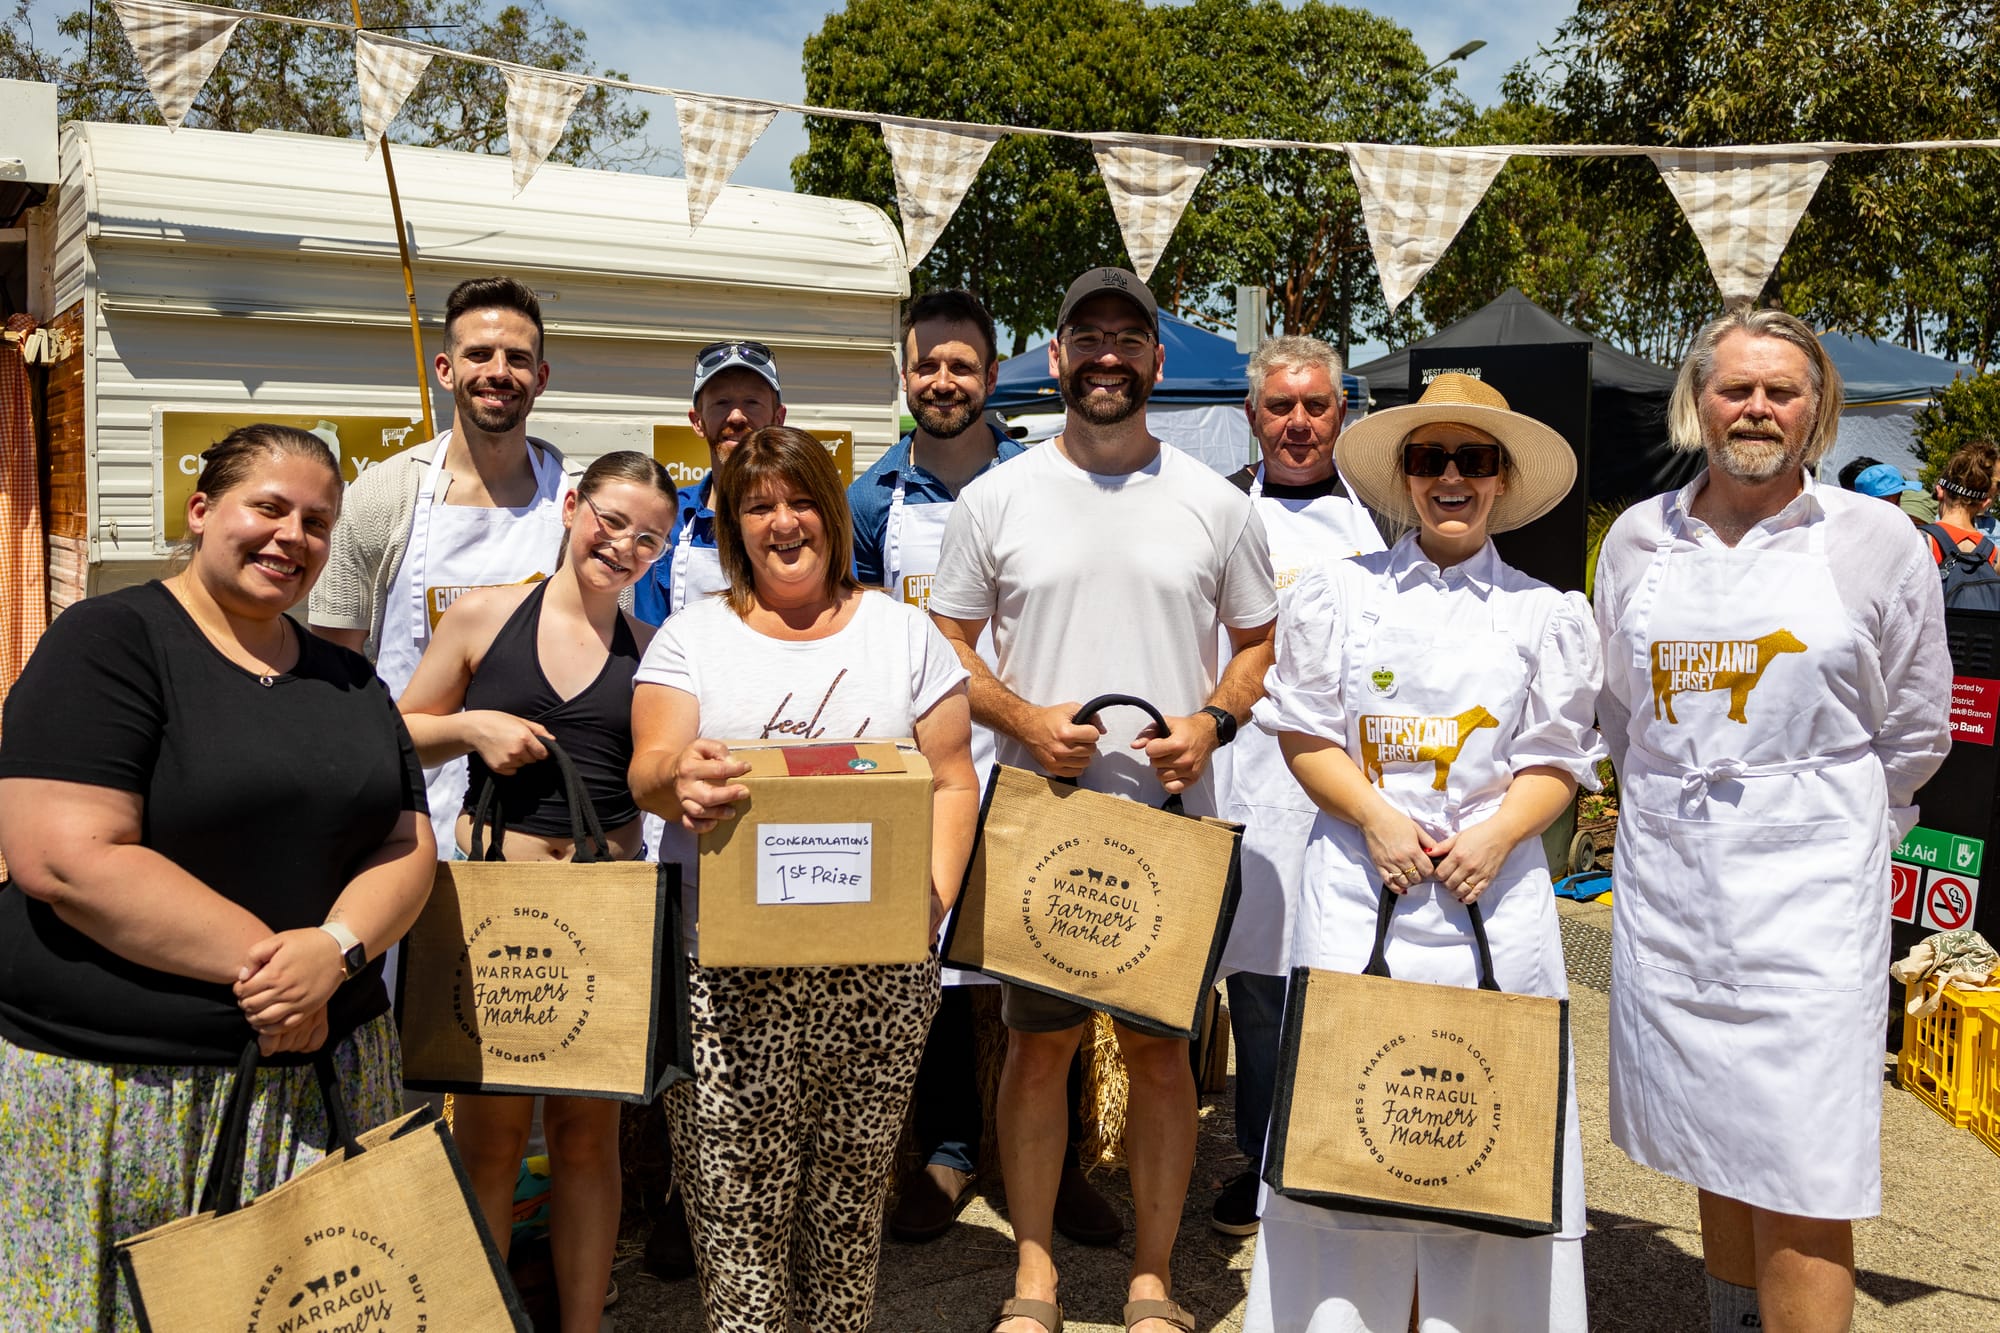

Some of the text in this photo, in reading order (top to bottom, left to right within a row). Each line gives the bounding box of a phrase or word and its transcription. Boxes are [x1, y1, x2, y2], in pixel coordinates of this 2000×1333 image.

[1422, 368, 1441, 376] WEST
[1658, 642, 1759, 674] GIPPSLAND
[1669, 671, 1717, 691] JERSEY
[1975, 685, 1985, 694] by
[1952, 696, 1975, 706] District
[1967, 709, 1992, 719] Branch
[1365, 716, 1459, 748] GIPPSLAND
[1960, 721, 1985, 734] Bank
[1377, 743, 1421, 762] JERSEY
[1035, 838, 1080, 872] MAKERS
[1103, 837, 1136, 856] SHOP
[1911, 843, 1938, 863] Aid
[1137, 857, 1162, 896] LOCAL
[1054, 877, 1140, 914] WARRAGUL
[513, 907, 549, 920] SHOP
[1022, 889, 1042, 949] GROWERS
[1045, 894, 1137, 932] Farmers
[553, 918, 588, 956] LOCAL
[1048, 916, 1122, 948] Market
[1150, 915, 1163, 941] BUY
[476, 965, 569, 980] WARRAGUL
[1043, 952, 1098, 979] SUPPORT
[1116, 944, 1151, 974] FRESH
[473, 982, 569, 1009] Farmers
[585, 974, 595, 1003] BUY
[483, 1004, 558, 1027] Market
[560, 1009, 590, 1048] FRESH
[1431, 1029, 1464, 1045] SHOP
[487, 1045, 546, 1063] SUPPORT
[1362, 1035, 1406, 1077] MAKERS
[1467, 1043, 1495, 1083] LOCAL
[1385, 1081, 1478, 1105] WARRAGUL
[1382, 1099, 1478, 1128] Farmers
[1492, 1103, 1501, 1132] BUY
[1355, 1097, 1385, 1164] GROWERS
[1389, 1124, 1467, 1149] Market
[1466, 1137, 1496, 1176] FRESH
[1387, 1165, 1448, 1187] SUPPORT
[303, 1226, 346, 1247] SHOP
[352, 1228, 396, 1260] LOCAL
[248, 1264, 284, 1333] MAKERS
[407, 1273, 427, 1304] BUY
[277, 1279, 388, 1333] WARRAGUL
